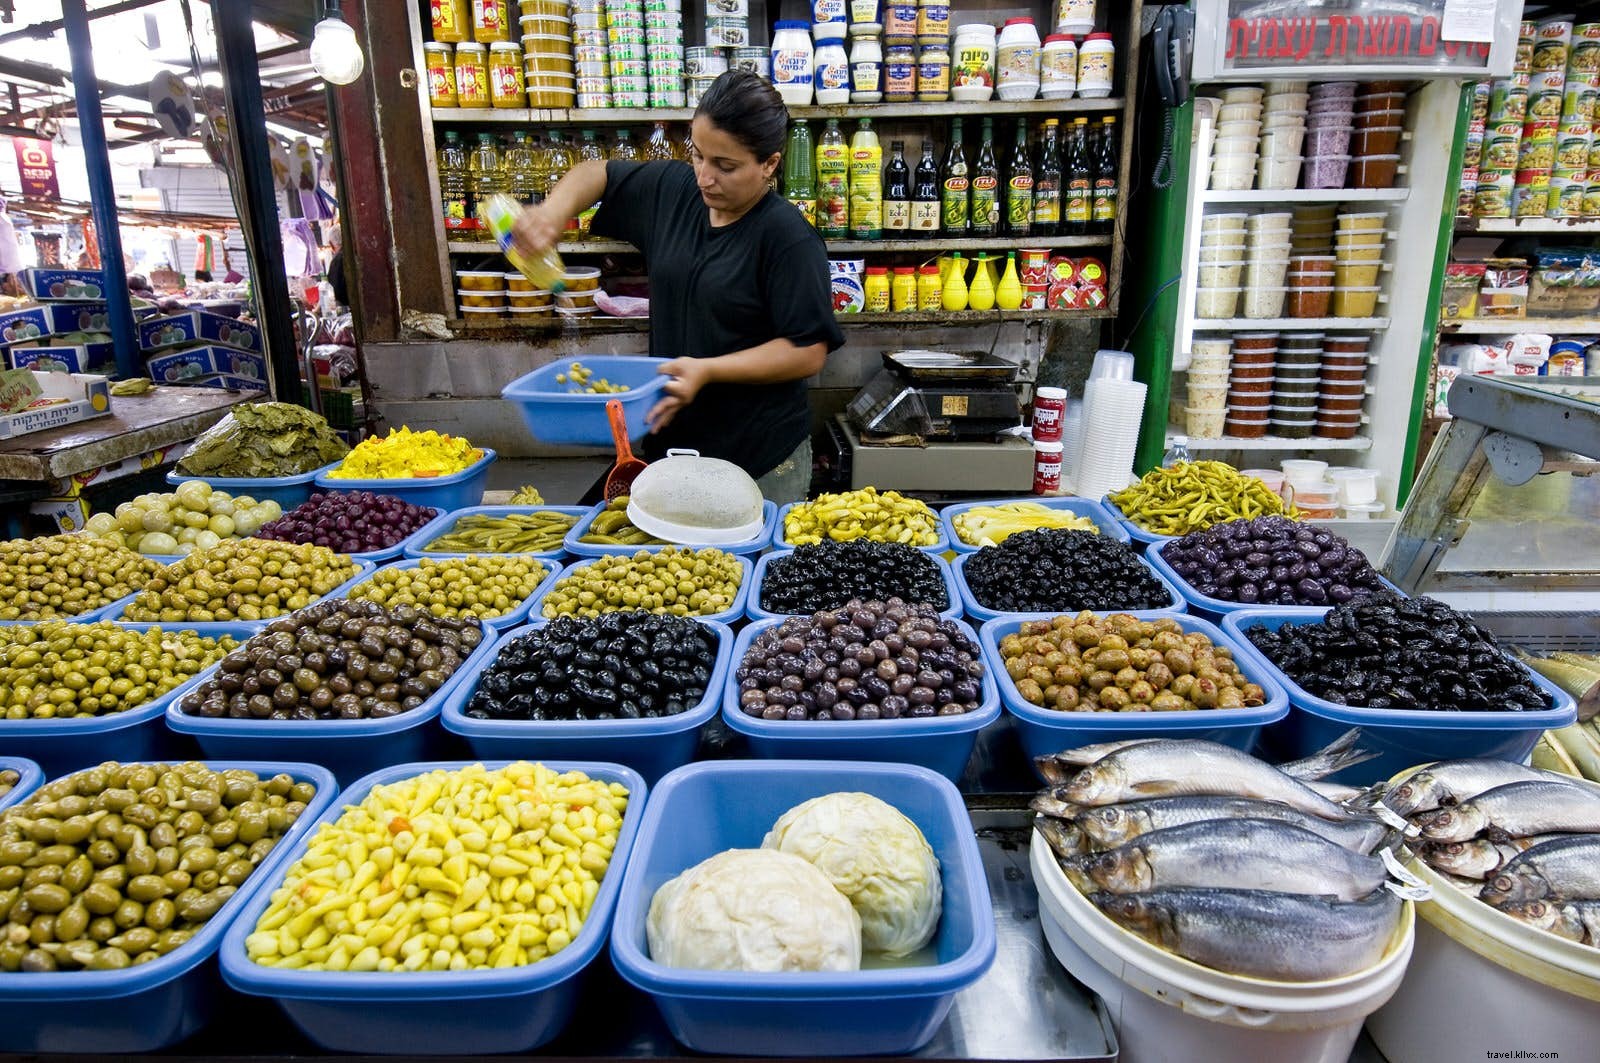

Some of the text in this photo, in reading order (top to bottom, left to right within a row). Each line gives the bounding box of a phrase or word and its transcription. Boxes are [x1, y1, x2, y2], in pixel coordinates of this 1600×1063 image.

[1226, 16, 1317, 62] עצמית
[1325, 15, 1412, 58] תוצרת
[960, 51, 990, 62] מיונז
[12, 405, 79, 428] פירות וירקות
[25, 417, 69, 431] מובחרים
